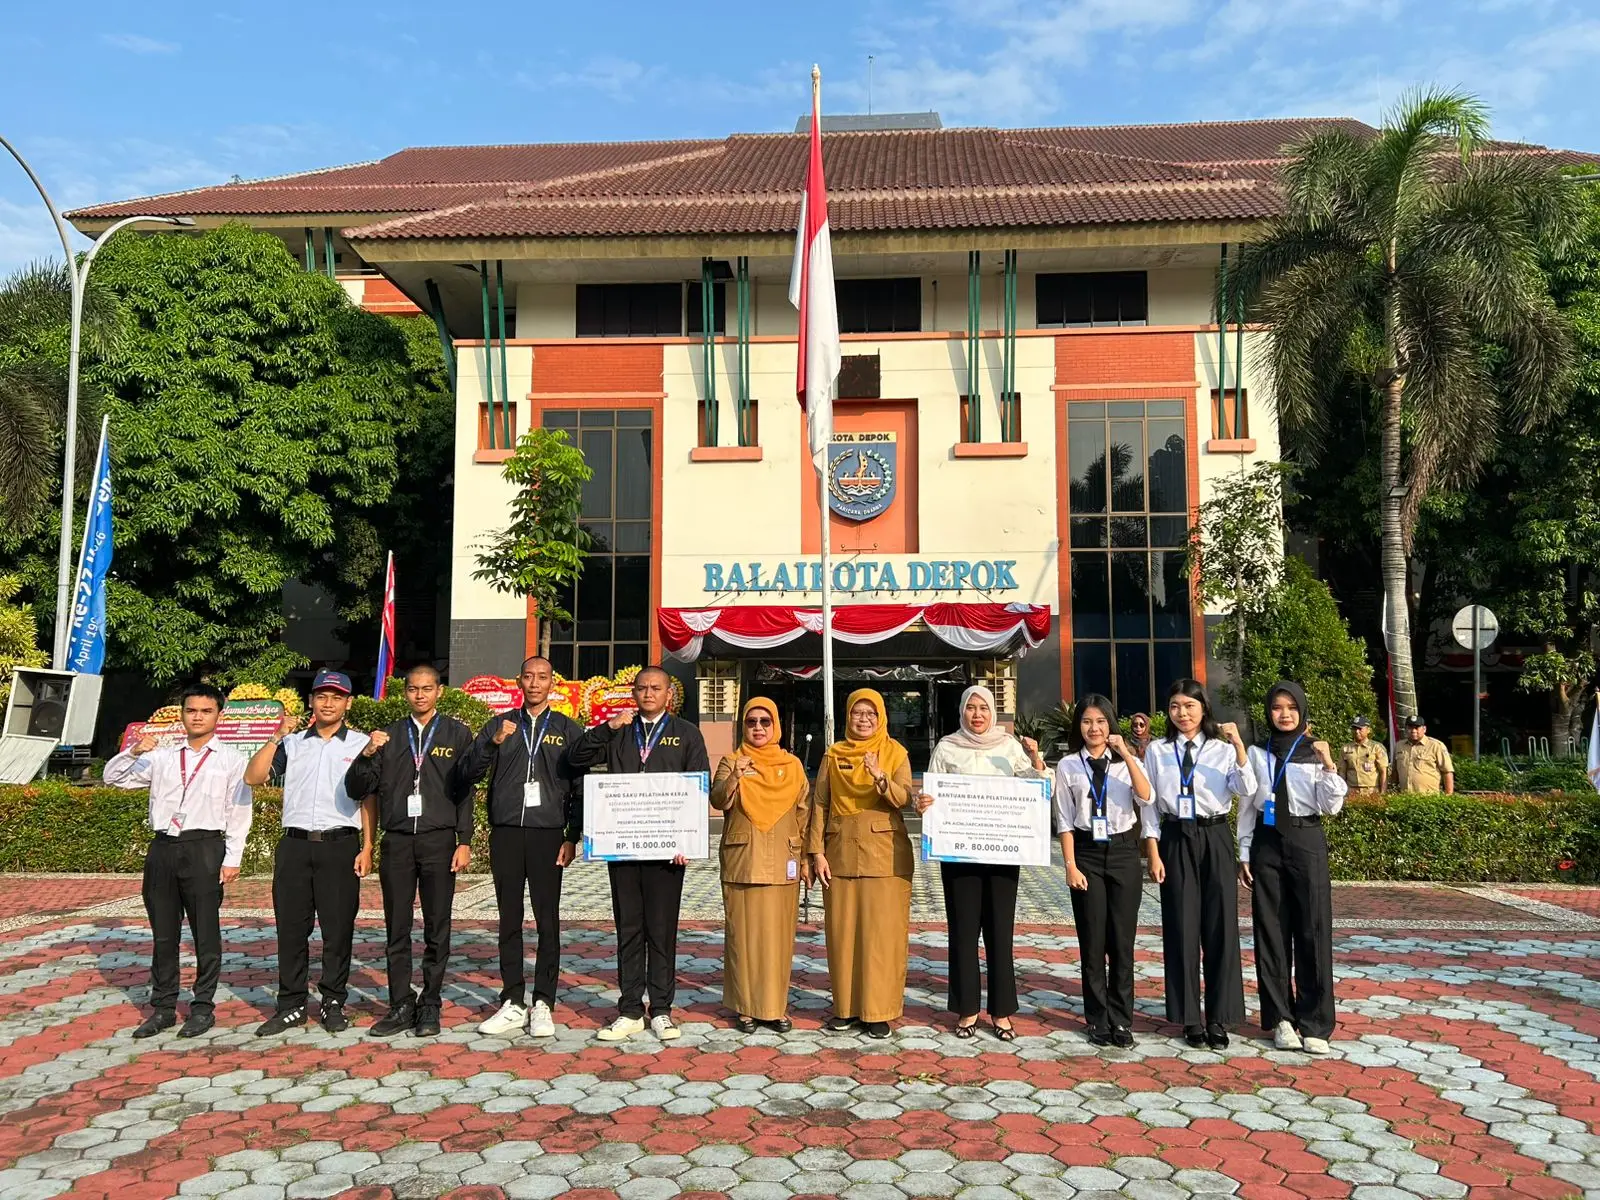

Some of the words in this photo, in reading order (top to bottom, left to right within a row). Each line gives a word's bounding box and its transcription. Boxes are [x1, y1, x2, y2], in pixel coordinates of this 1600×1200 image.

[907, 560, 1018, 590] DEPOK
[75, 639, 93, 668] April
[542, 734, 564, 746] ATC
[659, 736, 680, 746] ATC
[431, 746, 454, 758] ATC
[971, 844, 1019, 852] 80.000.000
